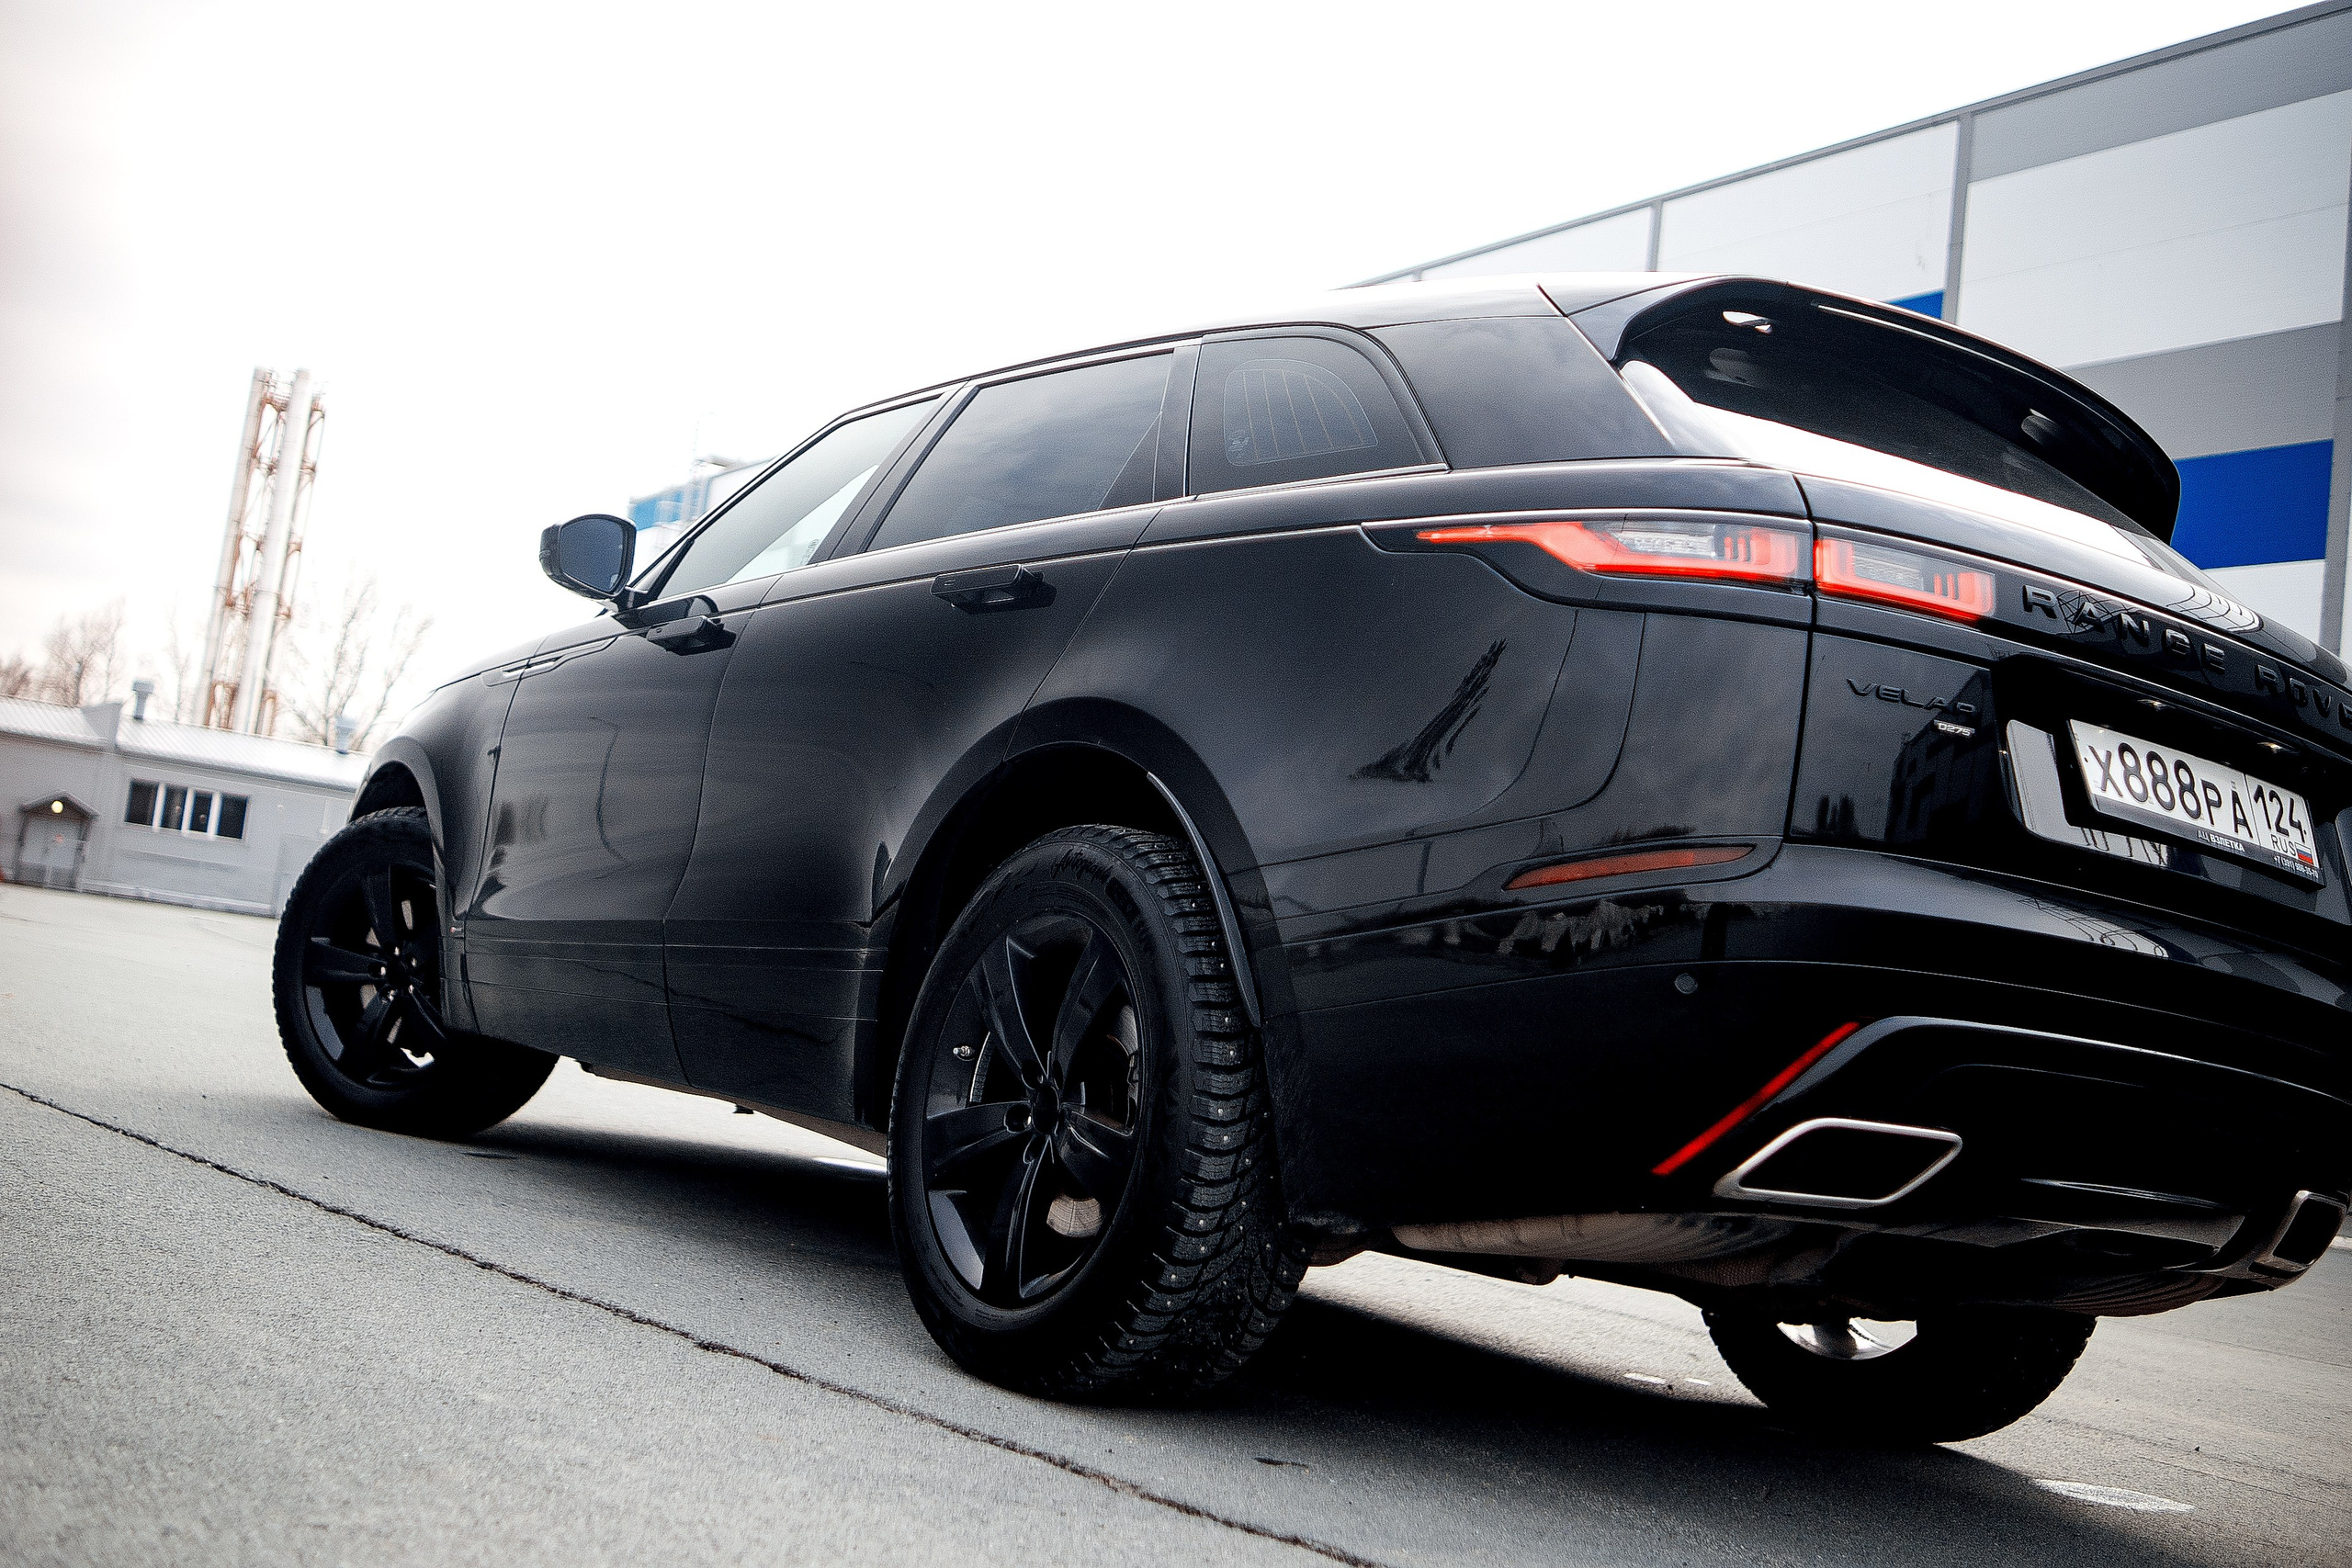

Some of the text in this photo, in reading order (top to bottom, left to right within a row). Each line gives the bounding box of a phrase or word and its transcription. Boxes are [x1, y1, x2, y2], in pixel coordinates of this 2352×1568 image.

[2021, 584, 2226, 675] RANGE
[1938, 722, 1972, 737] D275
[2253, 784, 2306, 844] 124
[2270, 833, 2297, 857] RUS
